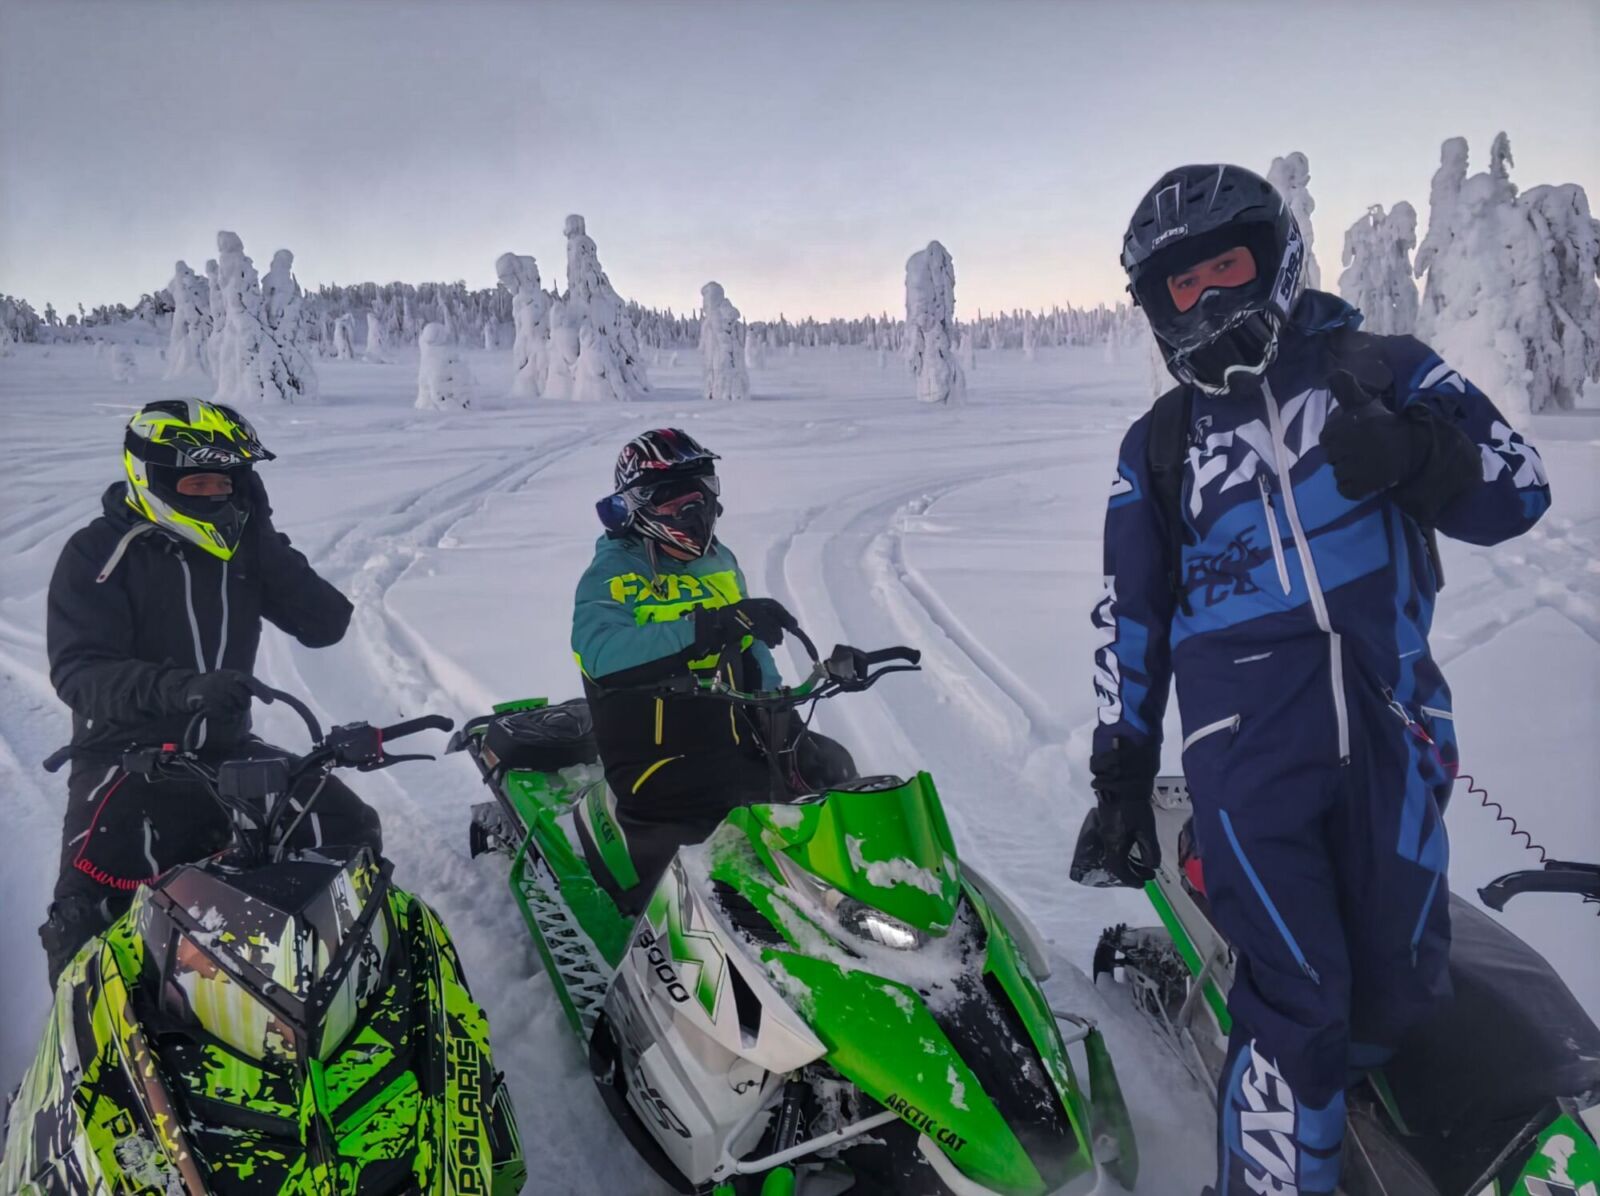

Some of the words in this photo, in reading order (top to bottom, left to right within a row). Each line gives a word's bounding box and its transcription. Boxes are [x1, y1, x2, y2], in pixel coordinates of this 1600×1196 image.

[601, 572, 704, 605] FXR
[456, 1038, 482, 1196] POLARIS
[883, 1093, 937, 1134] ARCTIC
[936, 1128, 968, 1152] CAT
